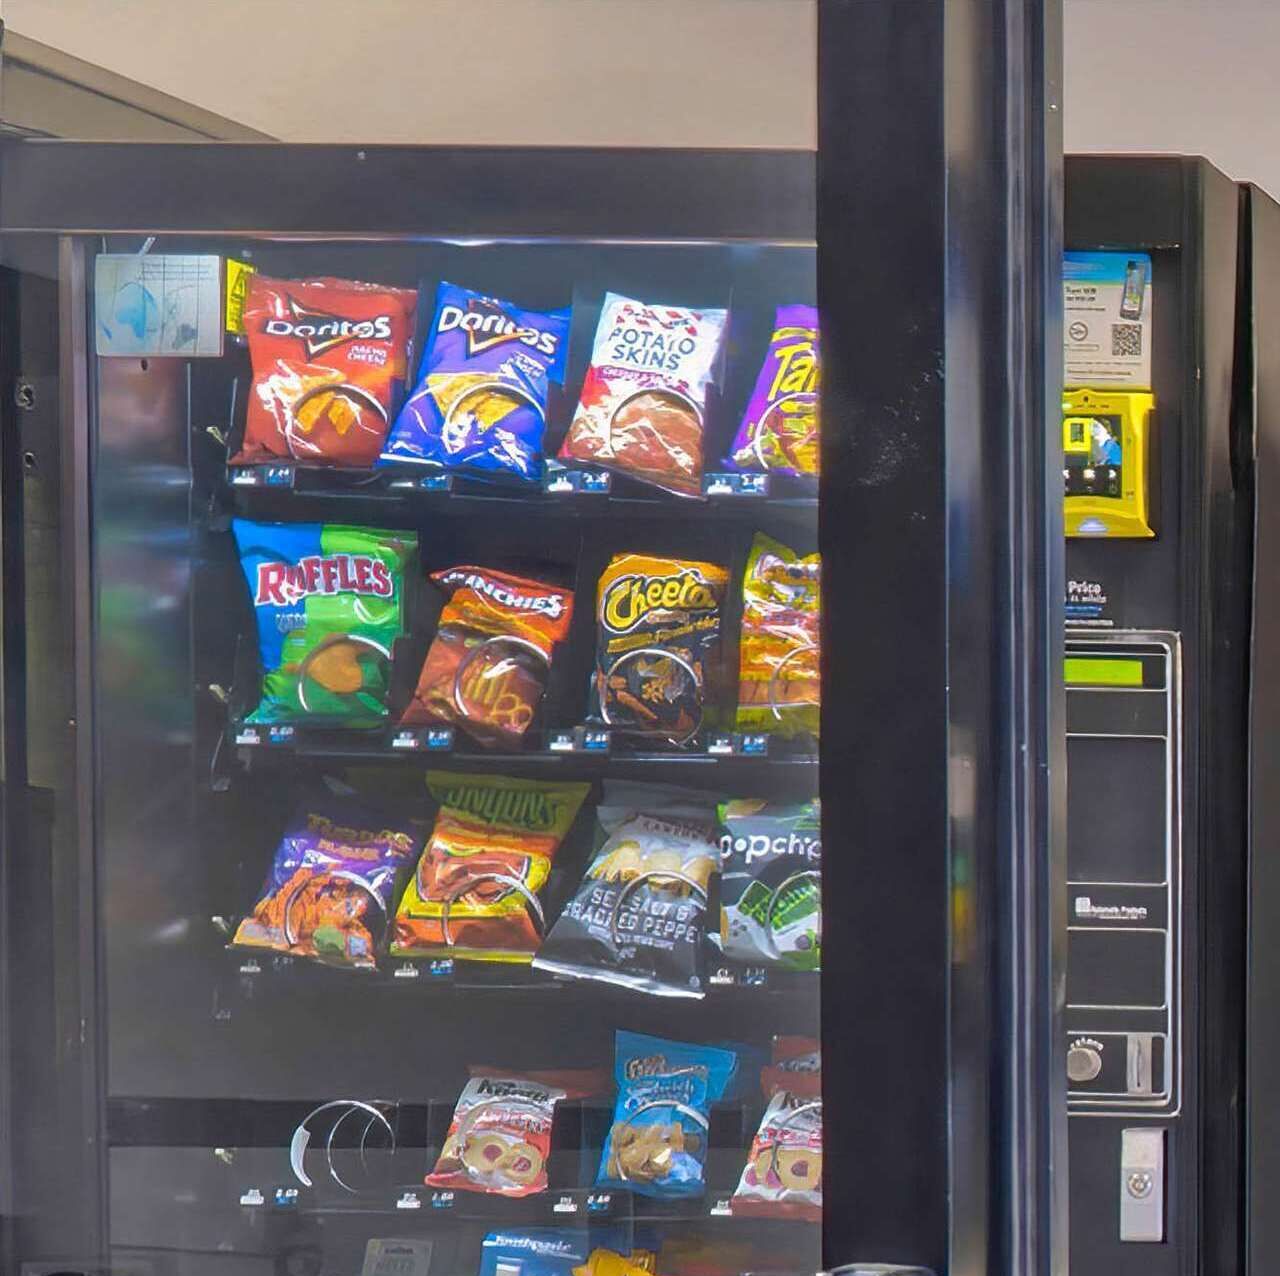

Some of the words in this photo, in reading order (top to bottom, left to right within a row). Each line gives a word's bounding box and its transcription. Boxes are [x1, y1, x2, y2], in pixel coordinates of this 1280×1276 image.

[265, 315, 392, 340] Doritos
[437, 306, 557, 355] Doritos
[608, 327, 696, 356] POTATO
[611, 345, 681, 371] SKINS
[767, 342, 820, 401] Ta
